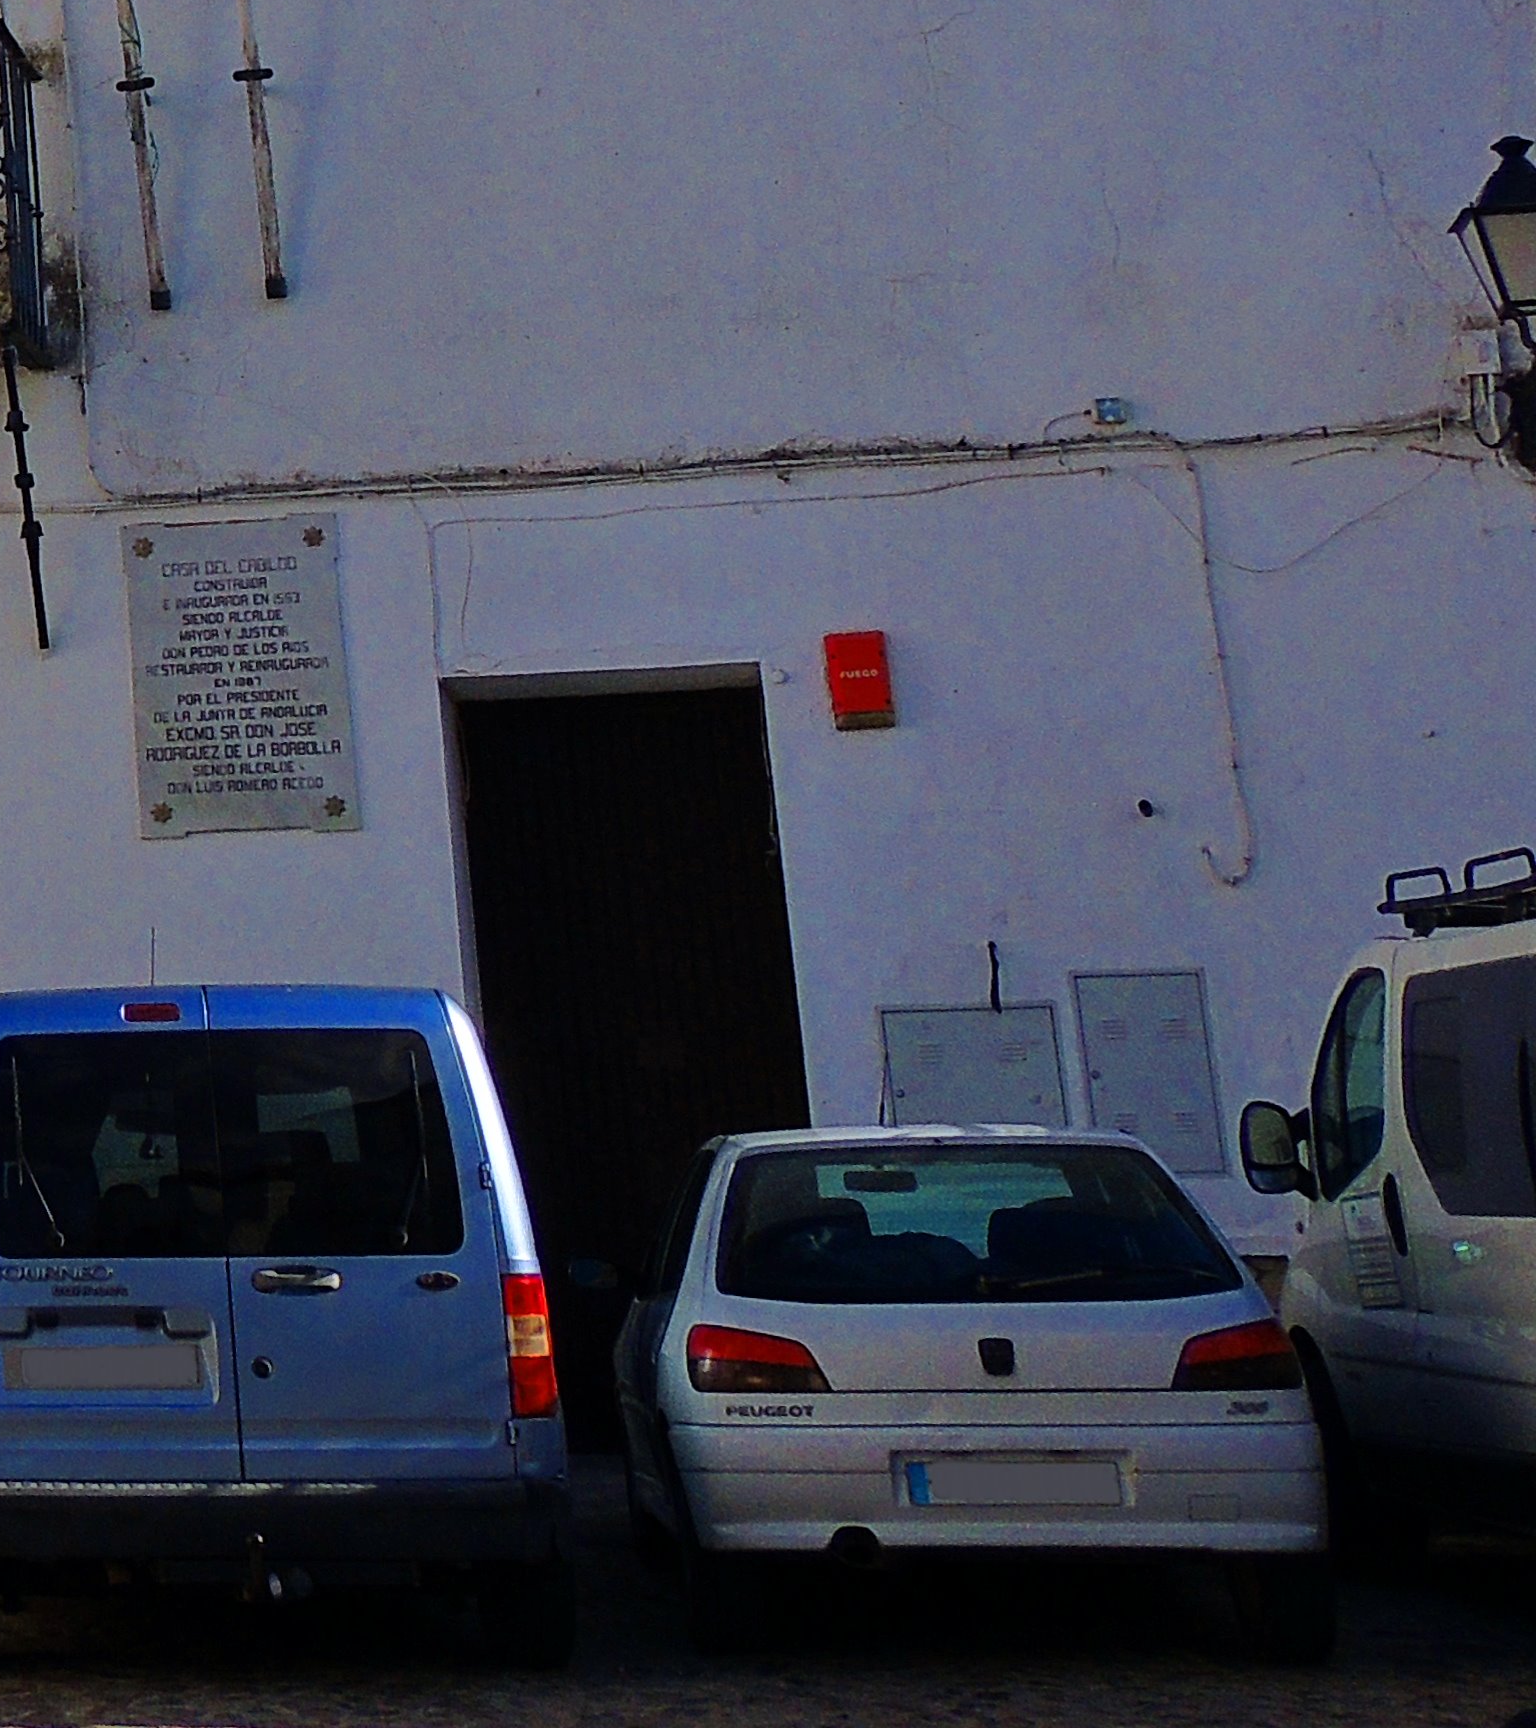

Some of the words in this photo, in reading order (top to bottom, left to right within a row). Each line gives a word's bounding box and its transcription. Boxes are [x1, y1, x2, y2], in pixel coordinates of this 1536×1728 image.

[161, 561, 200, 578] CASA
[205, 559, 232, 575] DEL
[238, 556, 298, 573] CABILDO
[194, 576, 268, 592] CONSTRUIDA
[176, 594, 249, 610] INAUGURADA
[253, 593, 269, 606] EN
[182, 611, 225, 626] SIENDO
[228, 609, 283, 623] ALCALDE
[179, 628, 220, 642] MAYOR
[225, 627, 232, 639] Y
[237, 625, 290, 639] JUSTICIA
[162, 646, 186, 660] DON
[190, 645, 229, 658] PEDRO
[233, 643, 249, 656] DE
[253, 642, 278, 656] LOS
[145, 661, 223, 677] RESTAURADA
[228, 660, 236, 672] Y
[240, 656, 330, 673] REINAUGURADA
[839, 668, 878, 679] FUEGO
[214, 677, 230, 688] EN
[178, 693, 202, 706] POR
[206, 692, 221, 705] EL
[227, 689, 301, 704] PRESIDENTE
[154, 711, 169, 724] DE
[174, 710, 191, 723] LA
[196, 708, 236, 722] JUNTA
[239, 707, 256, 720] DE
[261, 703, 328, 719] ANDALUCIA
[245, 724, 274, 739] DON
[280, 722, 317, 738] JOSE
[146, 745, 220, 762] RODRIGUEZ
[225, 744, 242, 759] DE
[247, 743, 266, 758] LA
[271, 739, 342, 757] BORBOLLA
[192, 762, 235, 777] SIENDO
[240, 760, 295, 774] ALCALDE
[167, 781, 192, 795] DON
[196, 780, 223, 794] LUIS
[228, 777, 278, 792] ROMERO
[725, 1404, 814, 1418] PEUGEOT
